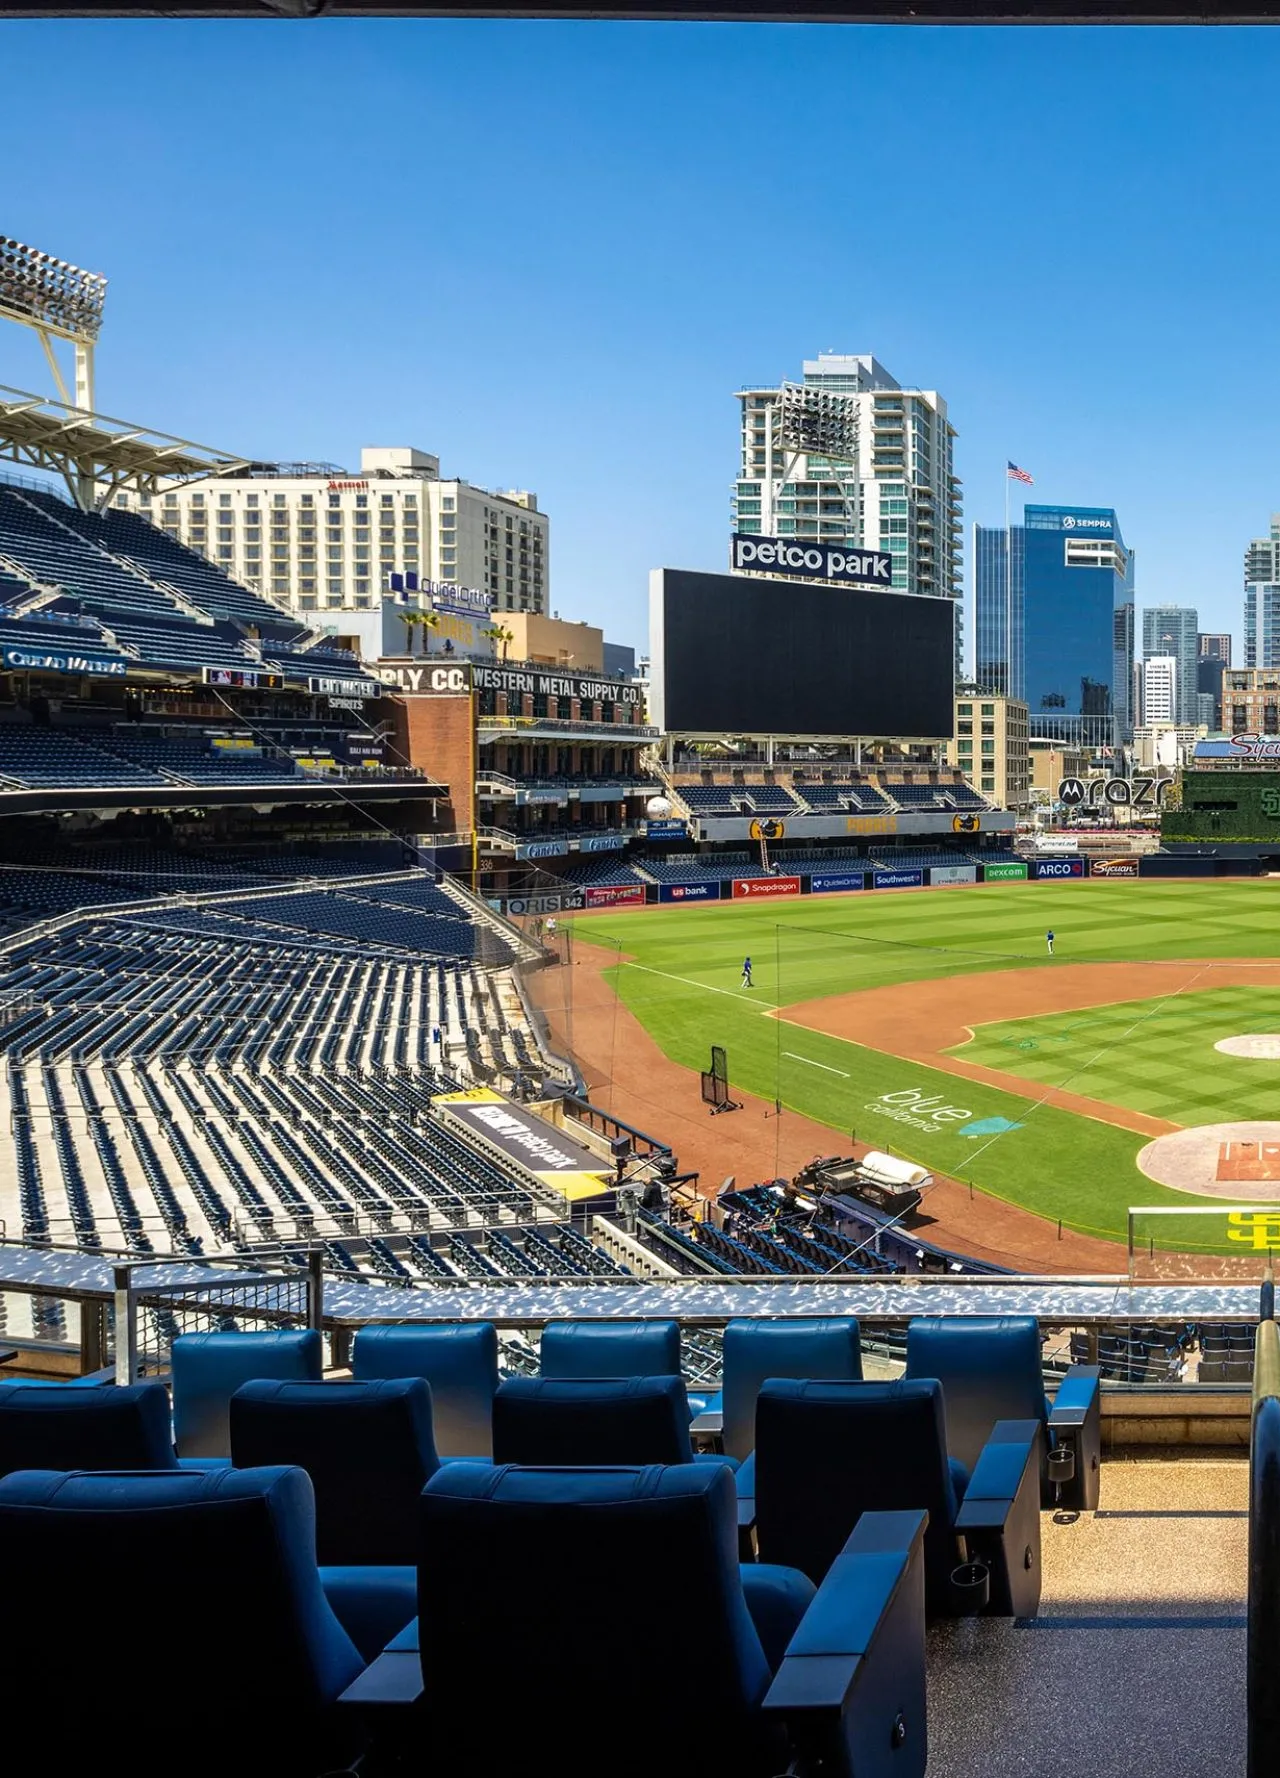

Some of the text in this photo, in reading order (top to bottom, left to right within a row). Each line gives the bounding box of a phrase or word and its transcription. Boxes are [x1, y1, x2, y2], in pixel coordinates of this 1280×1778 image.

[1076, 519, 1112, 529] SEMPRA
[736, 539, 890, 578] petco park
[431, 668, 470, 691] CO.
[472, 667, 640, 703] WESTERN METAL SUPPLY CO.
[328, 698, 364, 710] SPIRITS
[1087, 777, 1175, 805] razr
[1038, 864, 1071, 875] ARCO
[1093, 860, 1134, 876] Sycuan
[823, 877, 862, 888] QuidelOrtho
[876, 874, 915, 885] Southwest
[672, 885, 708, 897] us bank
[752, 882, 797, 893] Snapdragon
[509, 897, 560, 914] ORIS
[564, 896, 583, 909] 342
[876, 1087, 972, 1121] blue
[863, 1102, 943, 1133] california
